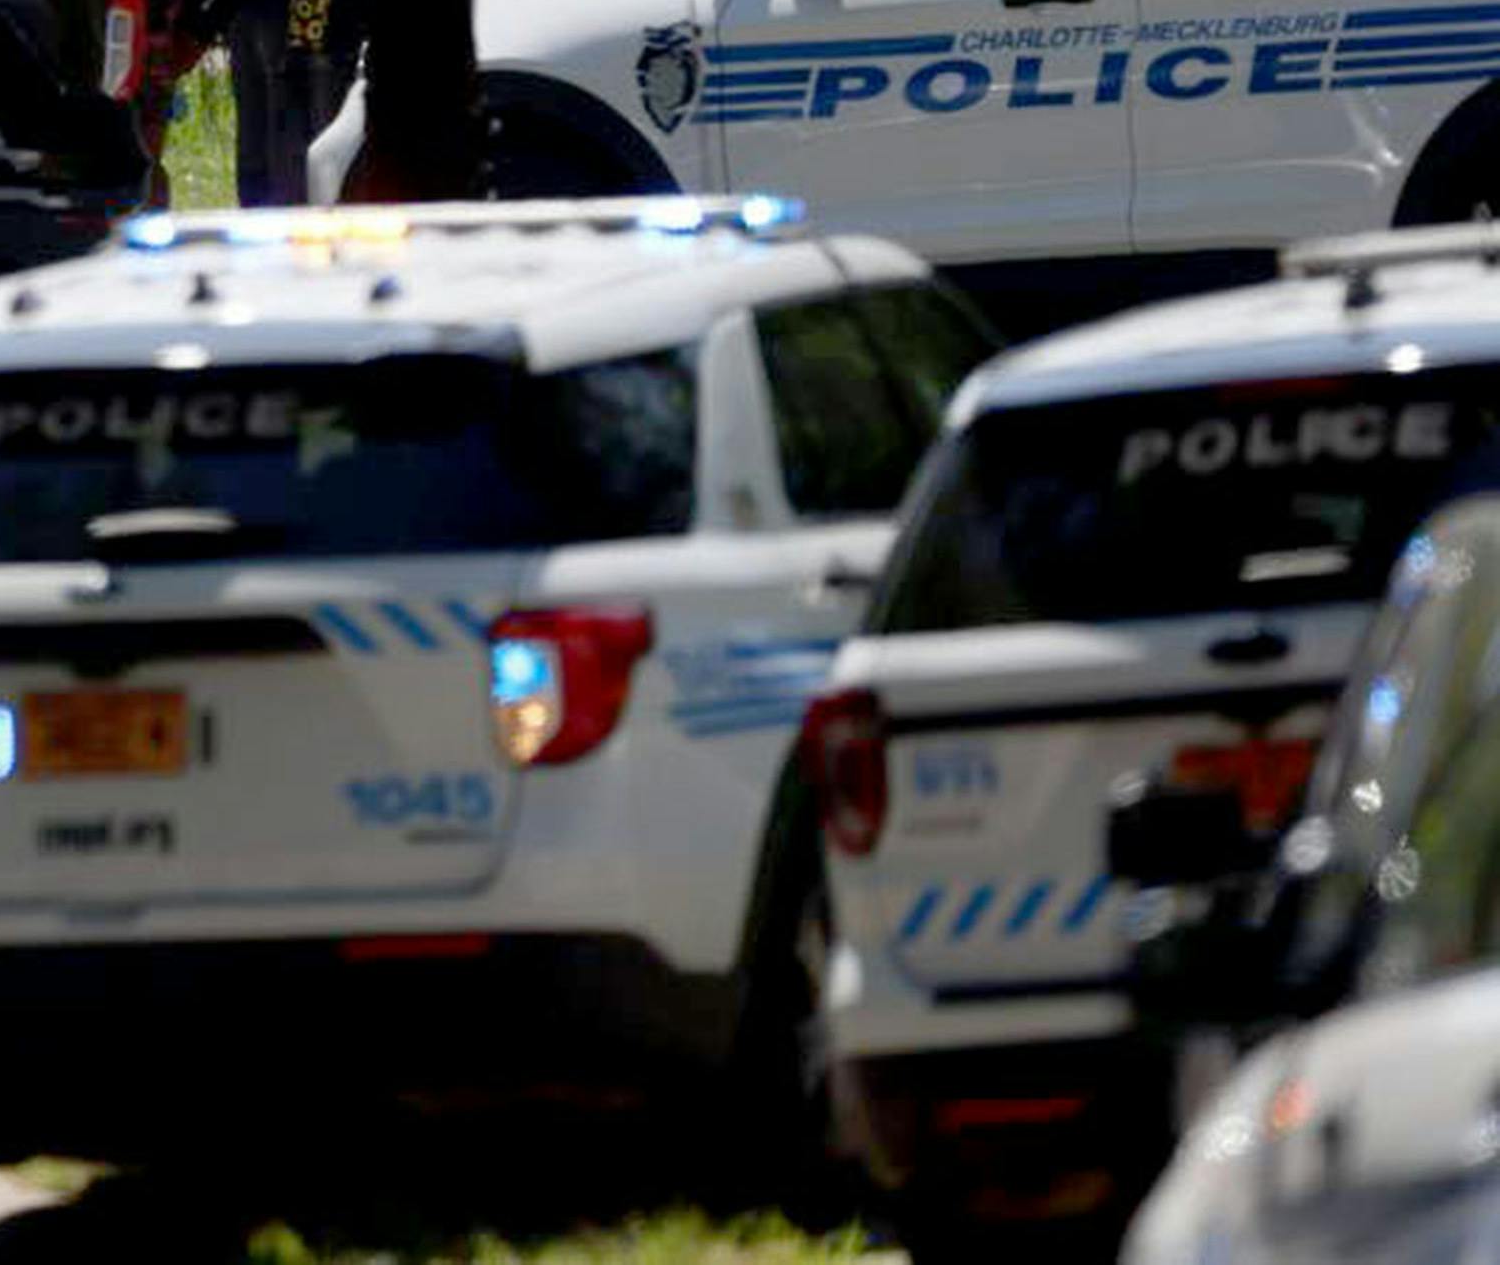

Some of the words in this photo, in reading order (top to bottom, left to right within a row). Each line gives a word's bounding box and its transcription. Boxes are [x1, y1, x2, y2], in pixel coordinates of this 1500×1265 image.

[960, 11, 1339, 53] CHARLOTTE-MECKLENBURG
[808, 38, 1331, 118] POLICE
[1119, 402, 1455, 484] POLICE
[346, 769, 492, 825] 1045
